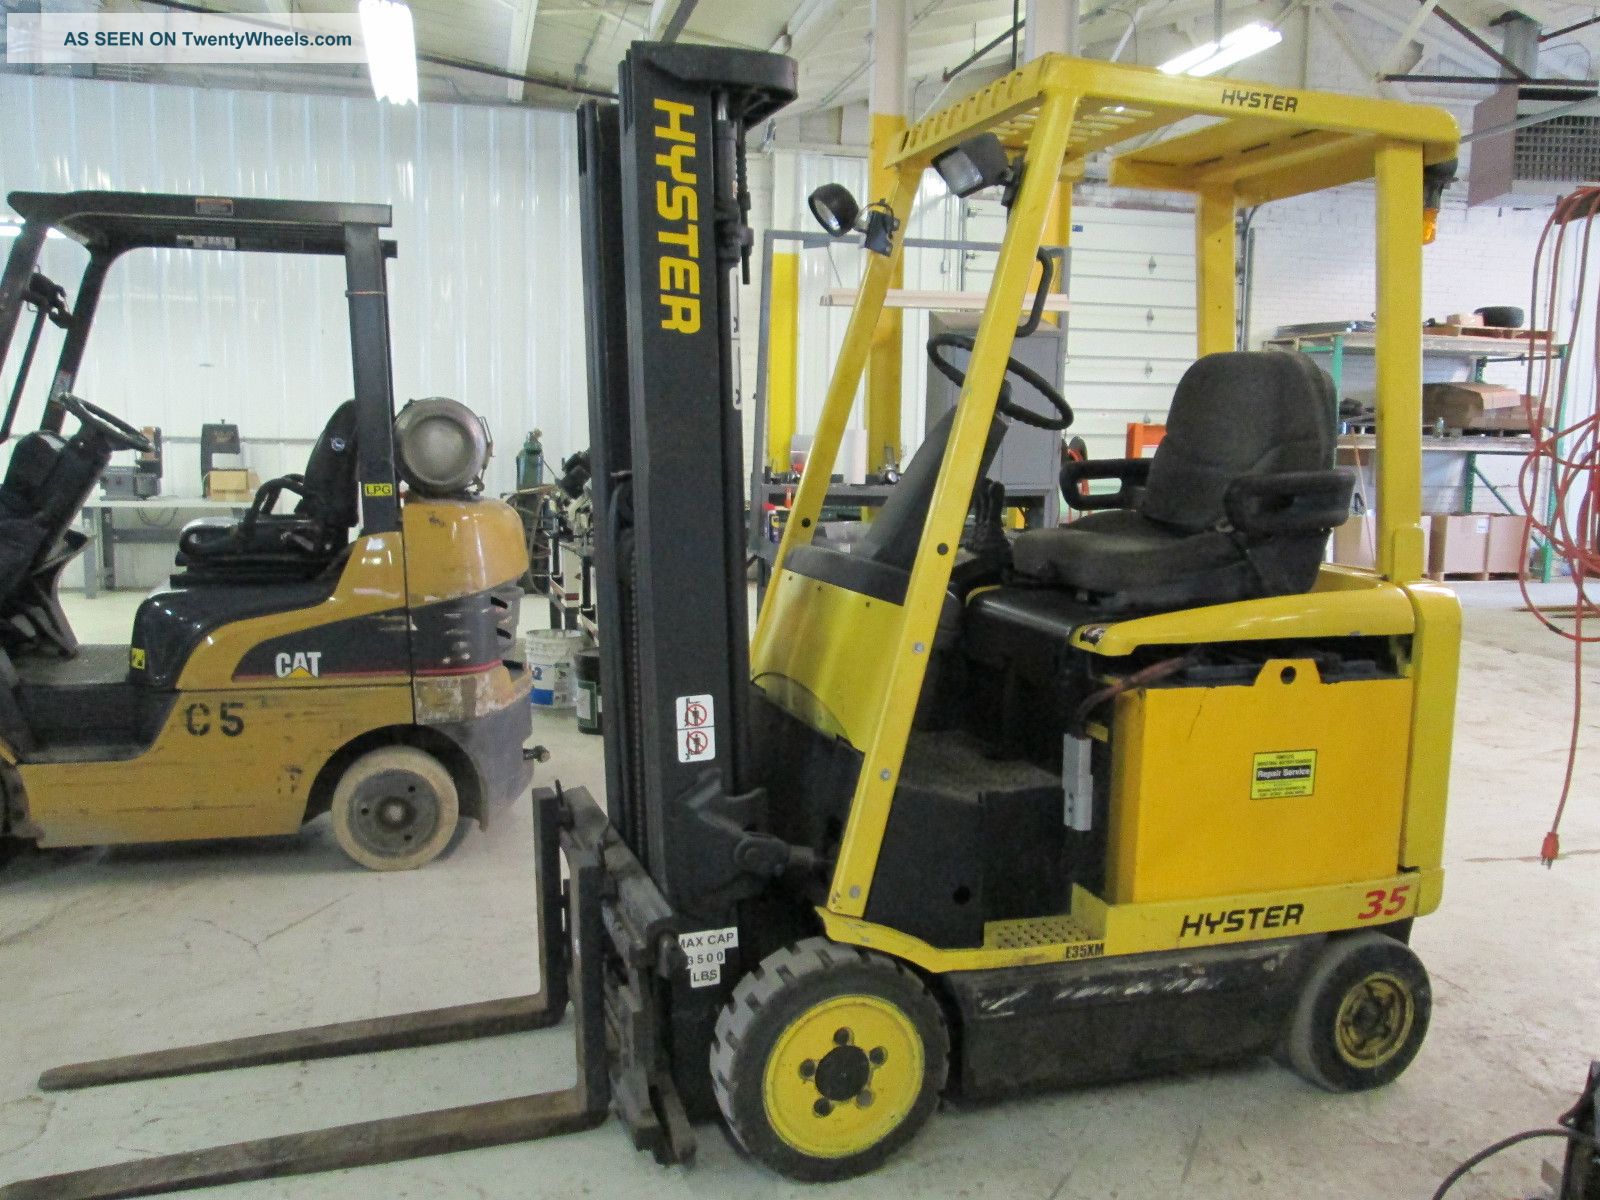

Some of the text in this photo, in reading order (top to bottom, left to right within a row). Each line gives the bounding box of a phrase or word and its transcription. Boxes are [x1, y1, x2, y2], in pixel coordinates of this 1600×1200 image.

[1221, 89, 1299, 113] HYSTER
[653, 97, 701, 335] HYSTER
[367, 485, 391, 495] LPG
[275, 652, 321, 678] CAT
[1257, 768, 1310, 779] Repair Service
[1180, 885, 1410, 938] HYSTER 35
[707, 932, 734, 945] CAP
[693, 968, 717, 982] LBS
